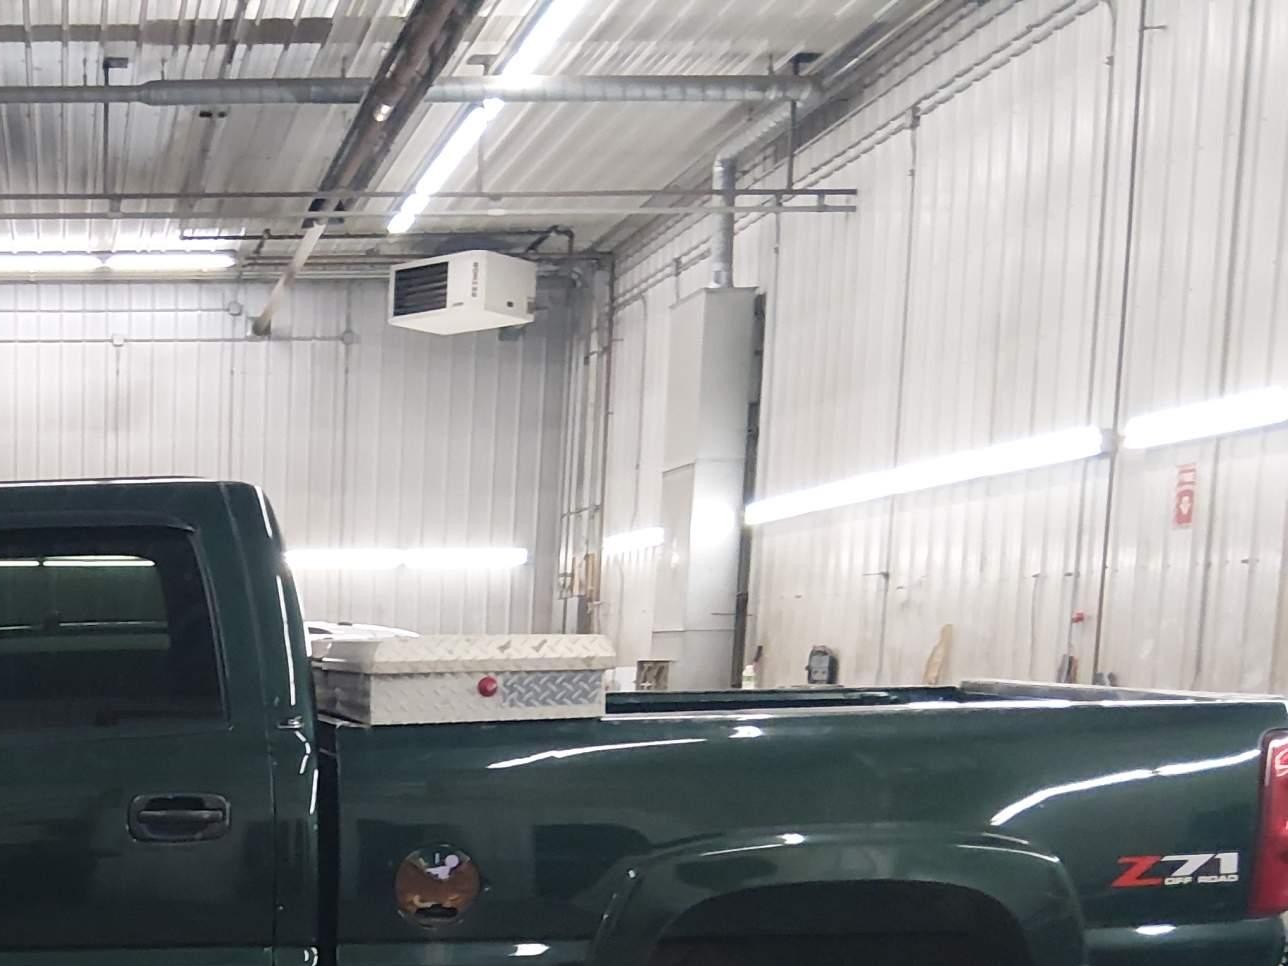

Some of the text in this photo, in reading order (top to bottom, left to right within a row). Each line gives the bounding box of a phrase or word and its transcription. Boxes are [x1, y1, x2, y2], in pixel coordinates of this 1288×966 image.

[1112, 852, 1239, 887] Z71
[1164, 874, 1239, 885] OFF ROAD
